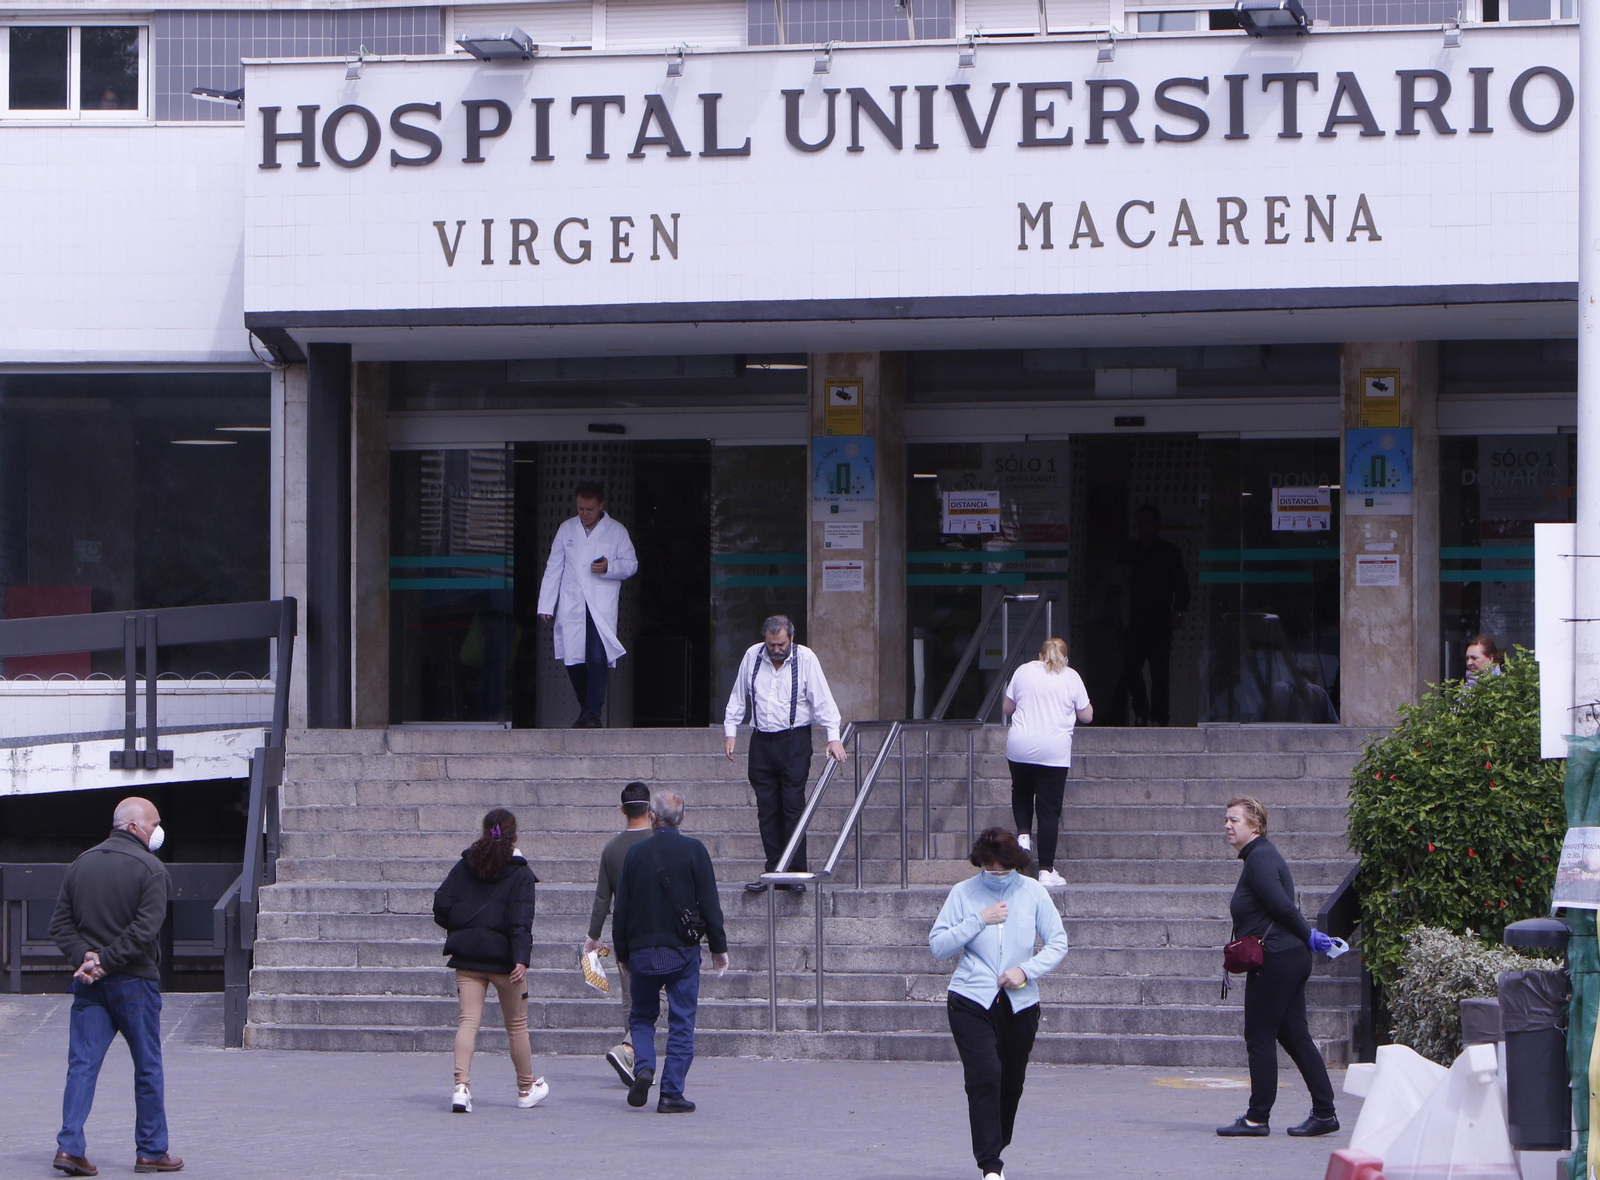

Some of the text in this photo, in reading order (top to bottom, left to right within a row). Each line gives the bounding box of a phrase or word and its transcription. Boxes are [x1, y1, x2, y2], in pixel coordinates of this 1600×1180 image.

[258, 65, 1575, 169] HOSPITAL UNIVERSITARIO
[433, 192, 1382, 267] VIRGEN MACARENA
[994, 454, 1056, 472] SÓLO 1
[1491, 448, 1539, 467] SÓLO
